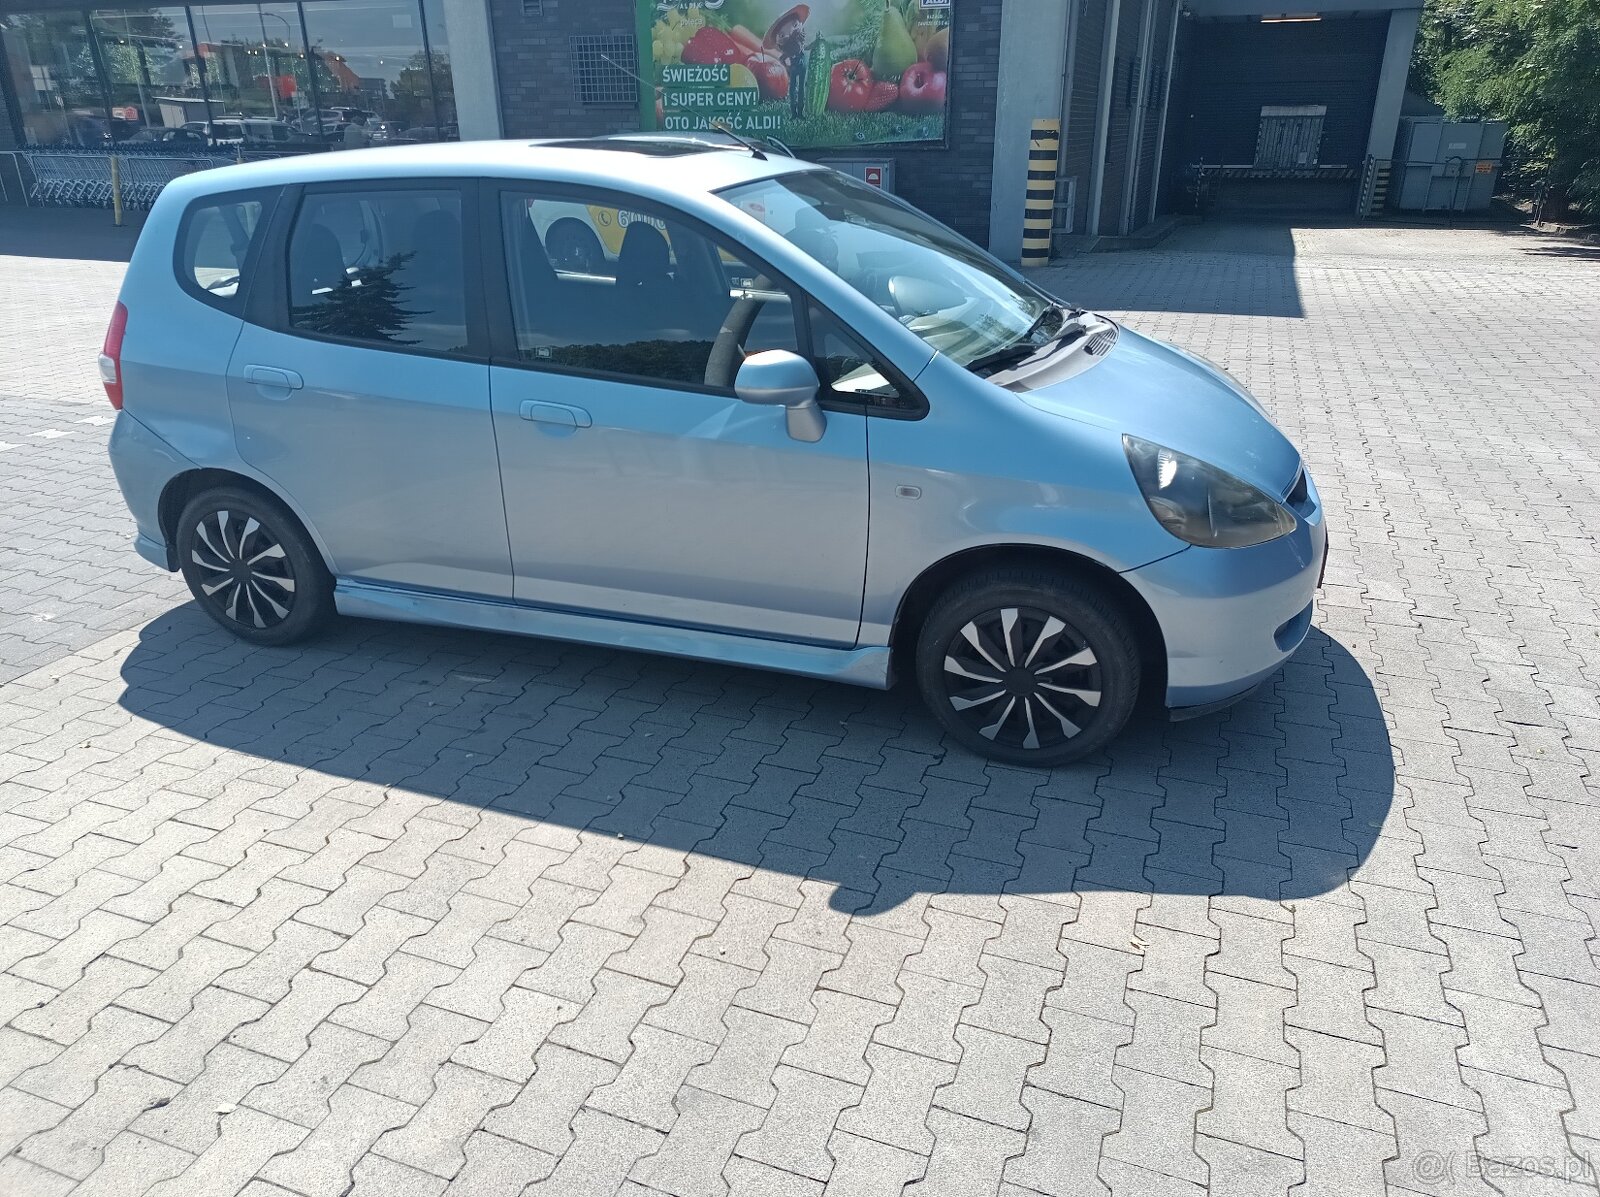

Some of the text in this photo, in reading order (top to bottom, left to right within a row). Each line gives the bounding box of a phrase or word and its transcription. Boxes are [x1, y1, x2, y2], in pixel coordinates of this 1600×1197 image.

[662, 64, 728, 82] ŚWIEŻOŚĆ
[671, 92, 714, 106] SUPER
[717, 91, 756, 106] CENY!
[665, 116, 689, 130] OTO
[745, 115, 781, 130] ALDI!
